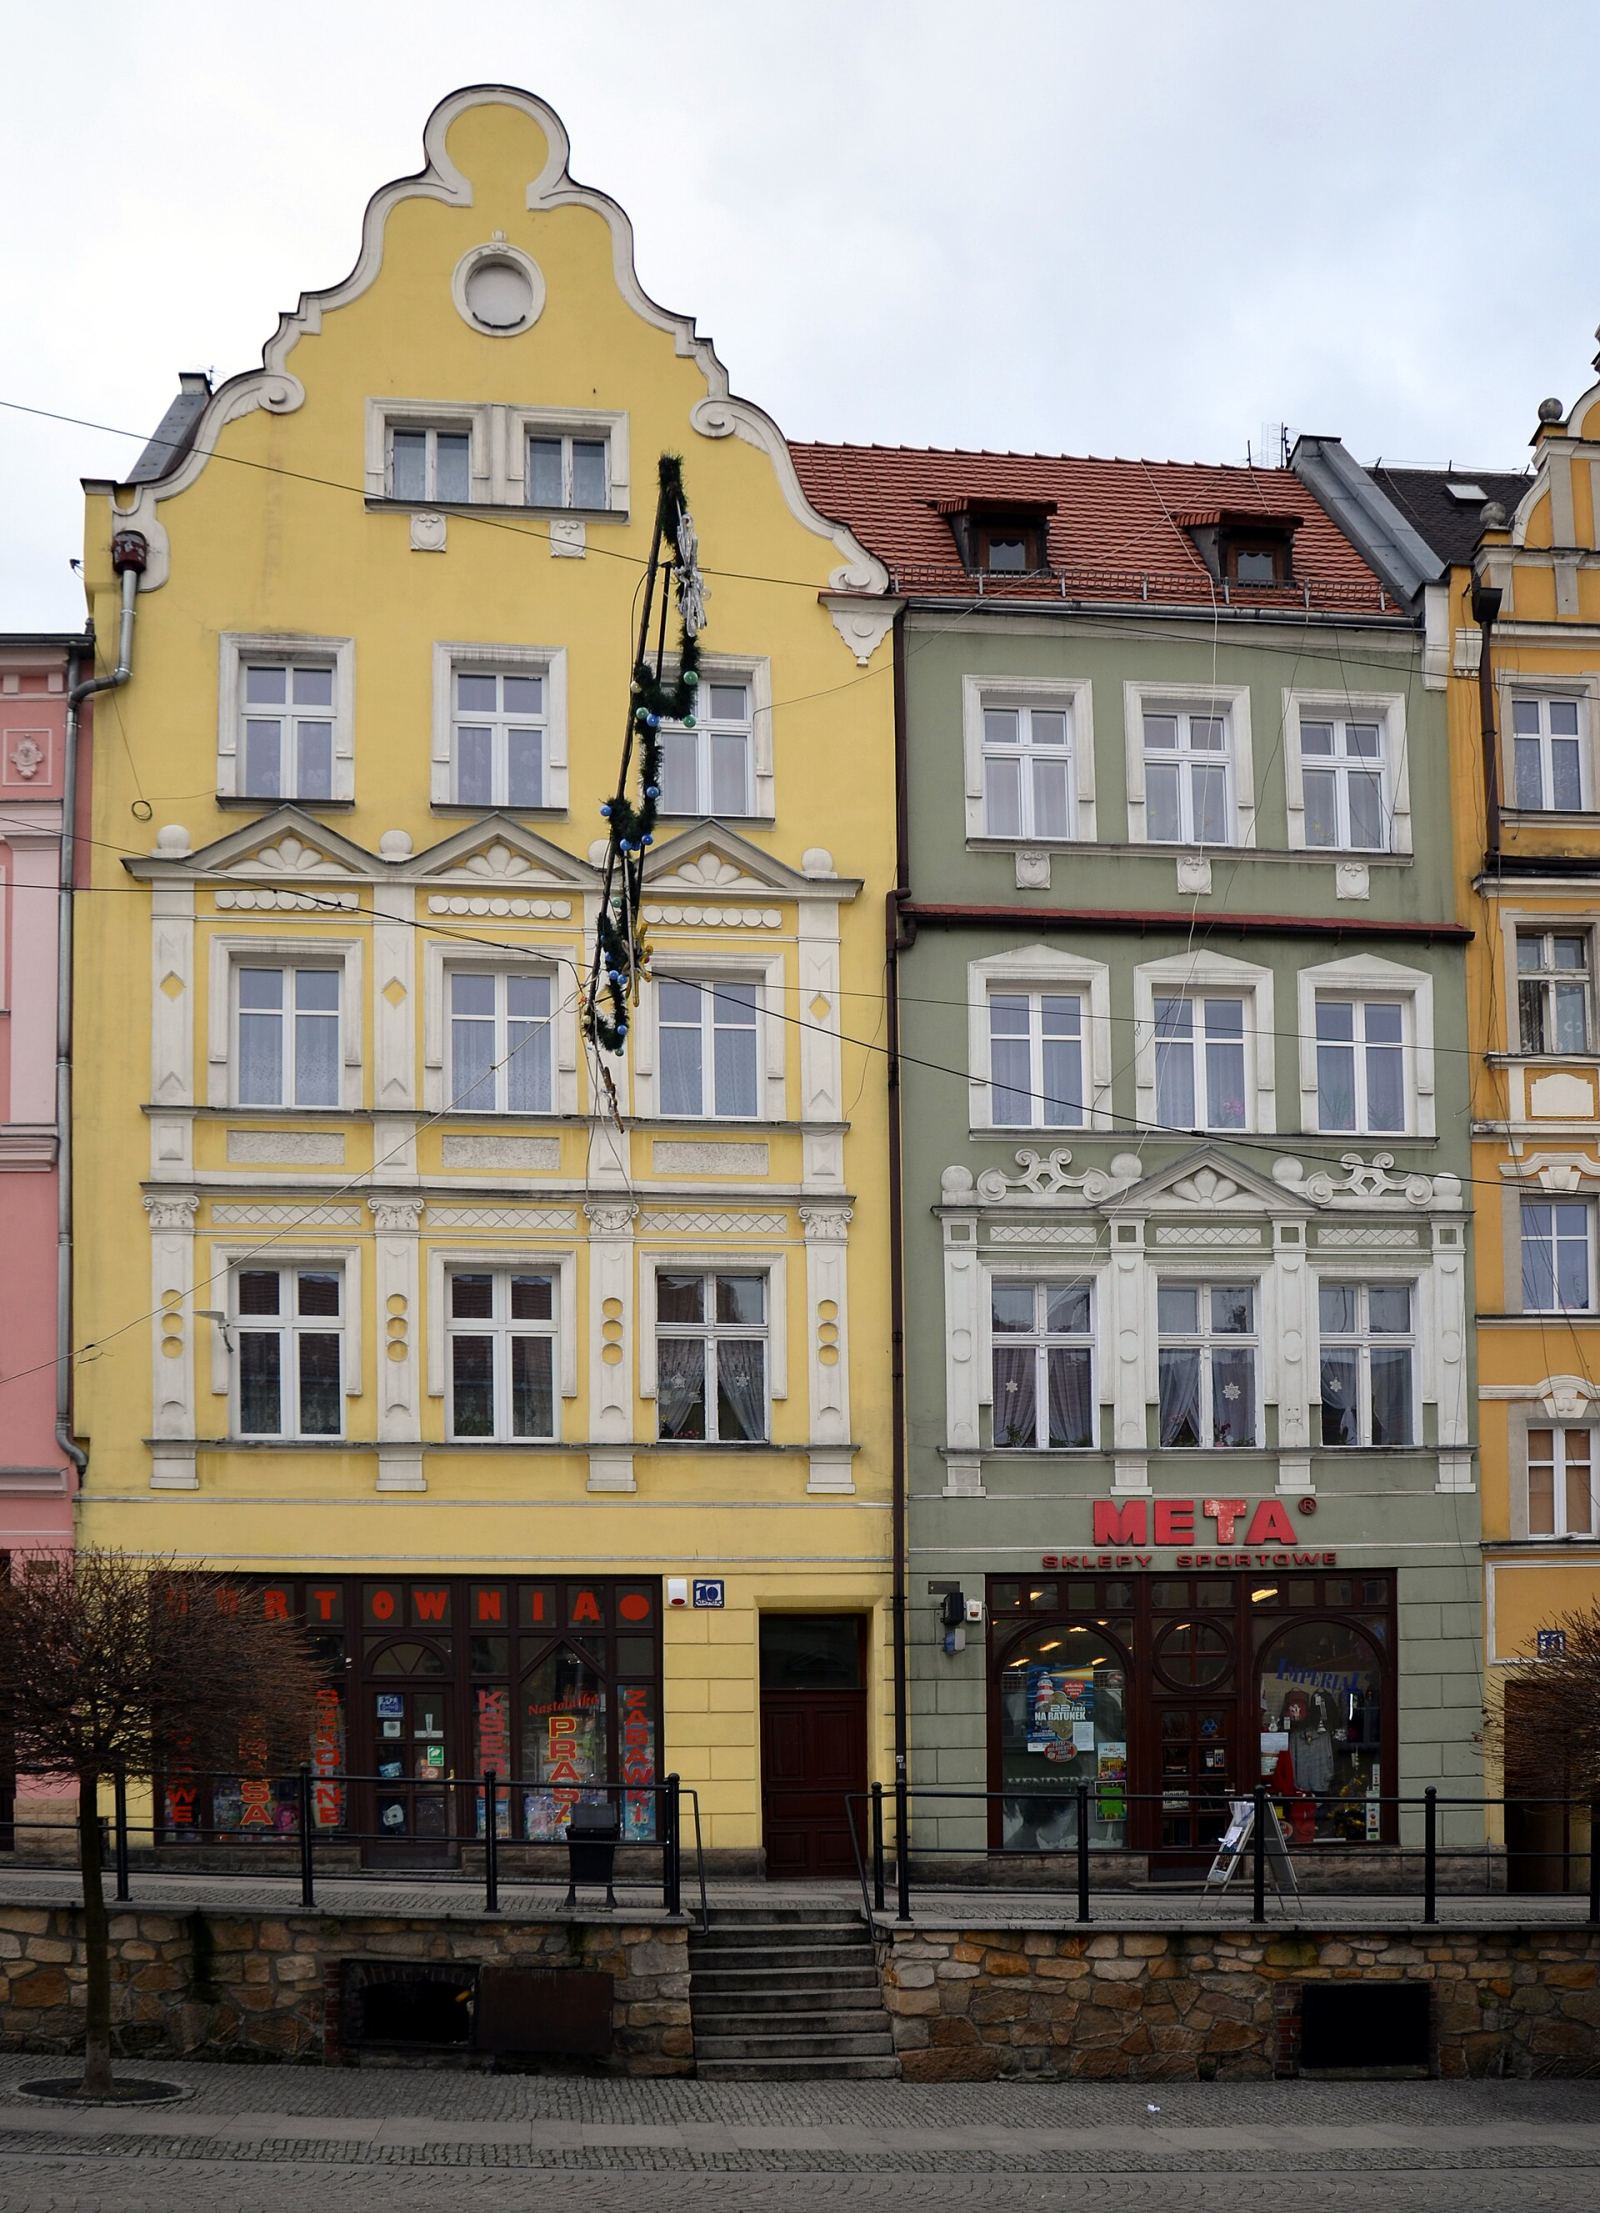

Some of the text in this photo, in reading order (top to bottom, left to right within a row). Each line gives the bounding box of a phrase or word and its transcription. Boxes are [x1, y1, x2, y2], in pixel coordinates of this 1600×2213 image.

[1092, 1499, 1298, 1545] META
[1041, 1551, 1338, 1569] SKLEPY SPORTOWE
[696, 1586, 718, 1601] 10
[1034, 1711, 1047, 1721] NA
